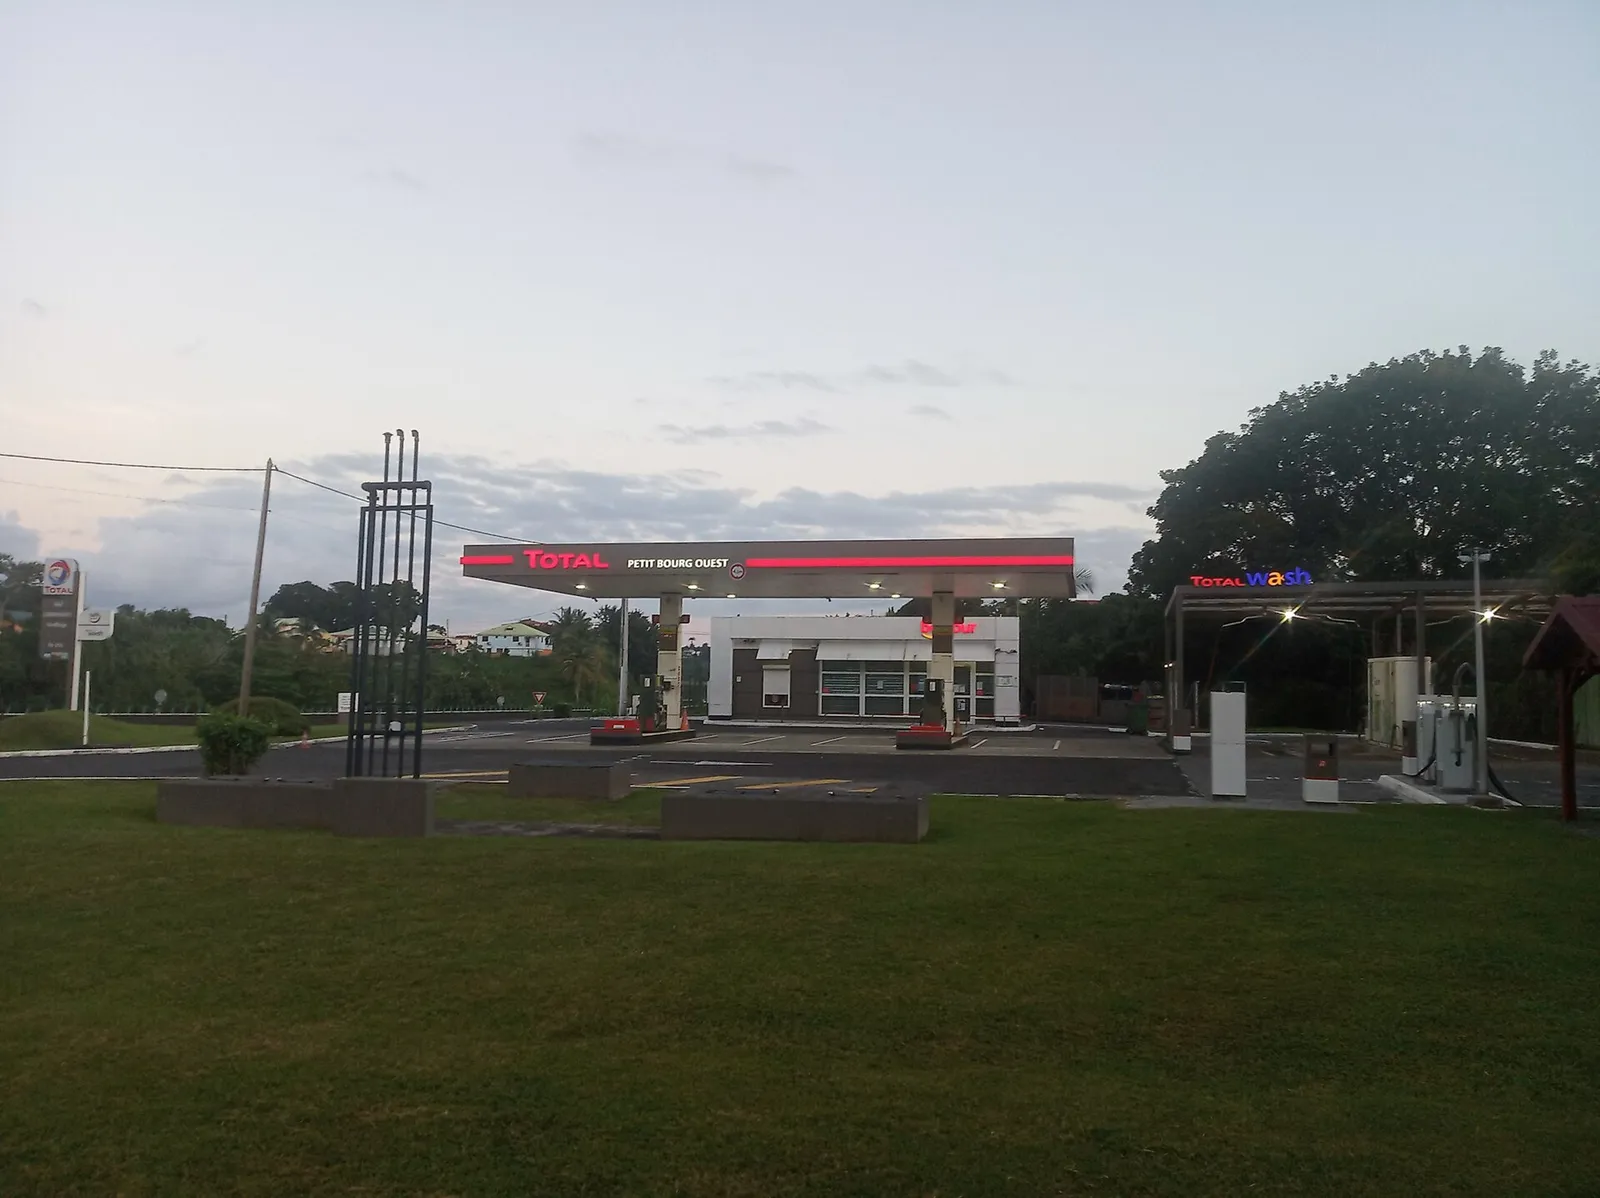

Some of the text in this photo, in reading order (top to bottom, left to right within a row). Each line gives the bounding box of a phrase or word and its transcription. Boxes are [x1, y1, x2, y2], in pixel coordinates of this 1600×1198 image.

[523, 549, 609, 570] TOTAL
[627, 557, 729, 569] PETIT BOURG OUEST
[1190, 566, 1312, 588] TOTAL wash
[45, 586, 73, 594] TOTAL
